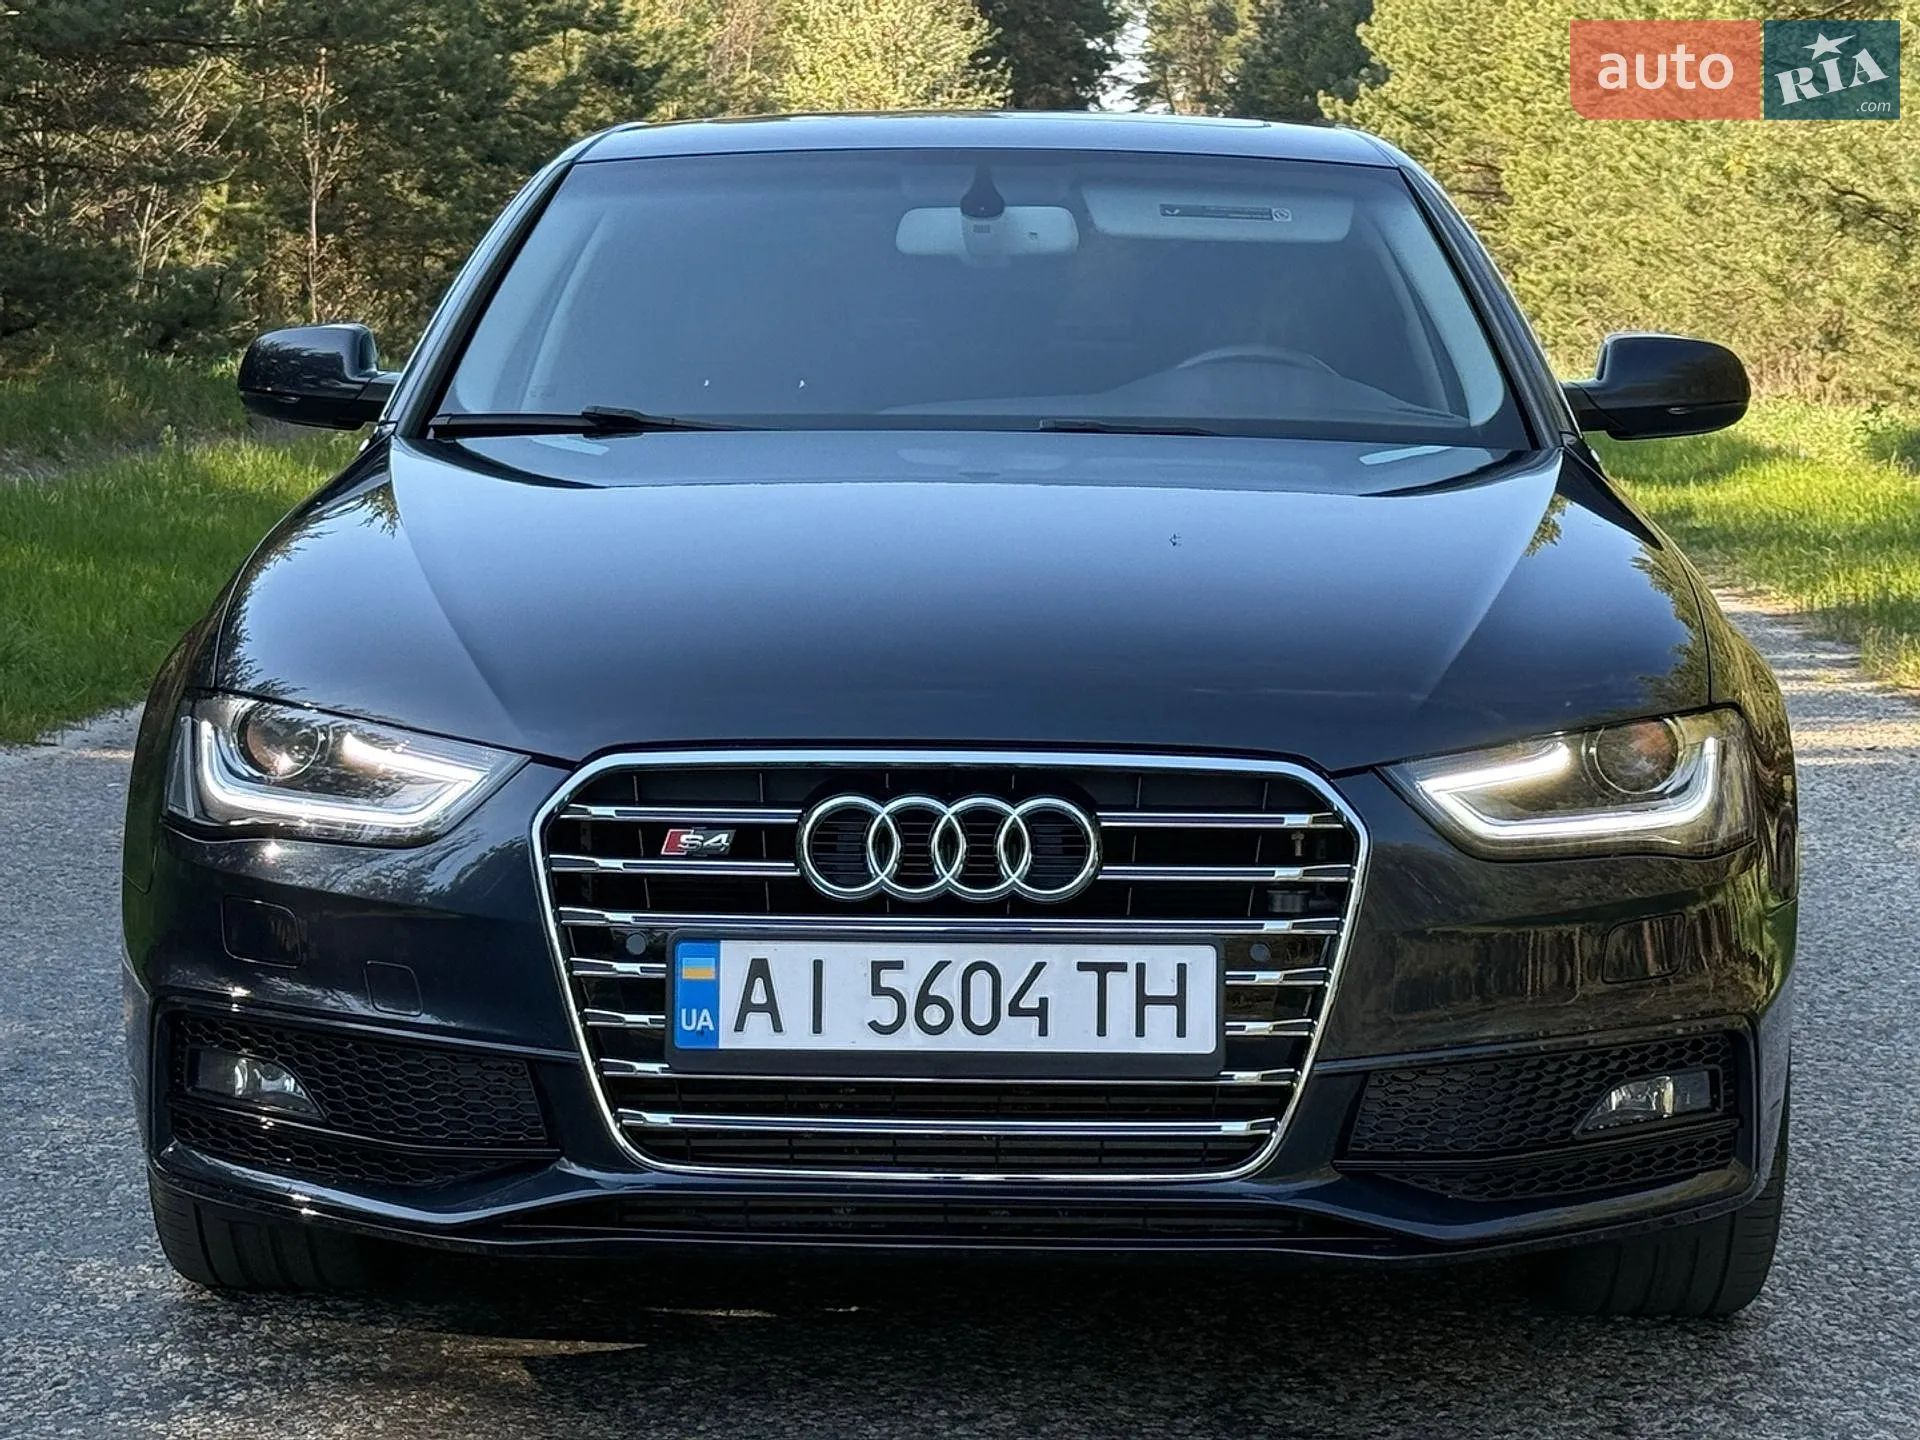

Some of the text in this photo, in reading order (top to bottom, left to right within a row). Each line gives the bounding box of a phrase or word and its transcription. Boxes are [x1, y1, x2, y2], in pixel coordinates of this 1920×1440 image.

[677, 833, 730, 852] S4
[867, 960, 1049, 1037] 5604
[1076, 961, 1187, 1038] TH
[681, 1008, 715, 1032] UA
